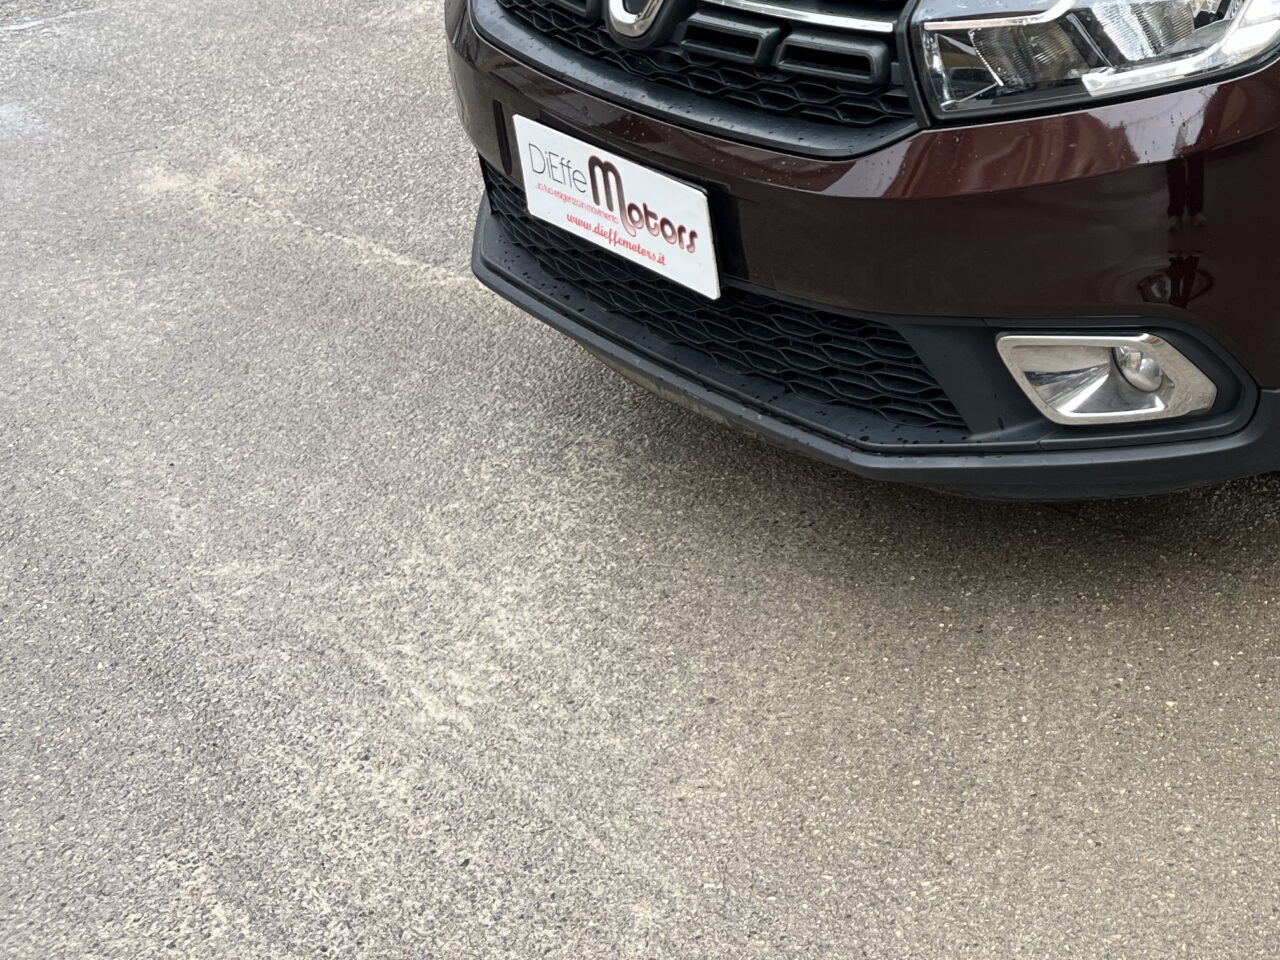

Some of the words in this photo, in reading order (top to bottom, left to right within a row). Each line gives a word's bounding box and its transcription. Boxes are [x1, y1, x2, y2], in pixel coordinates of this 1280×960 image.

[528, 143, 588, 193] DiEffe
[587, 155, 698, 253] Motors
[566, 213, 666, 265] www.dieffemotors.it
